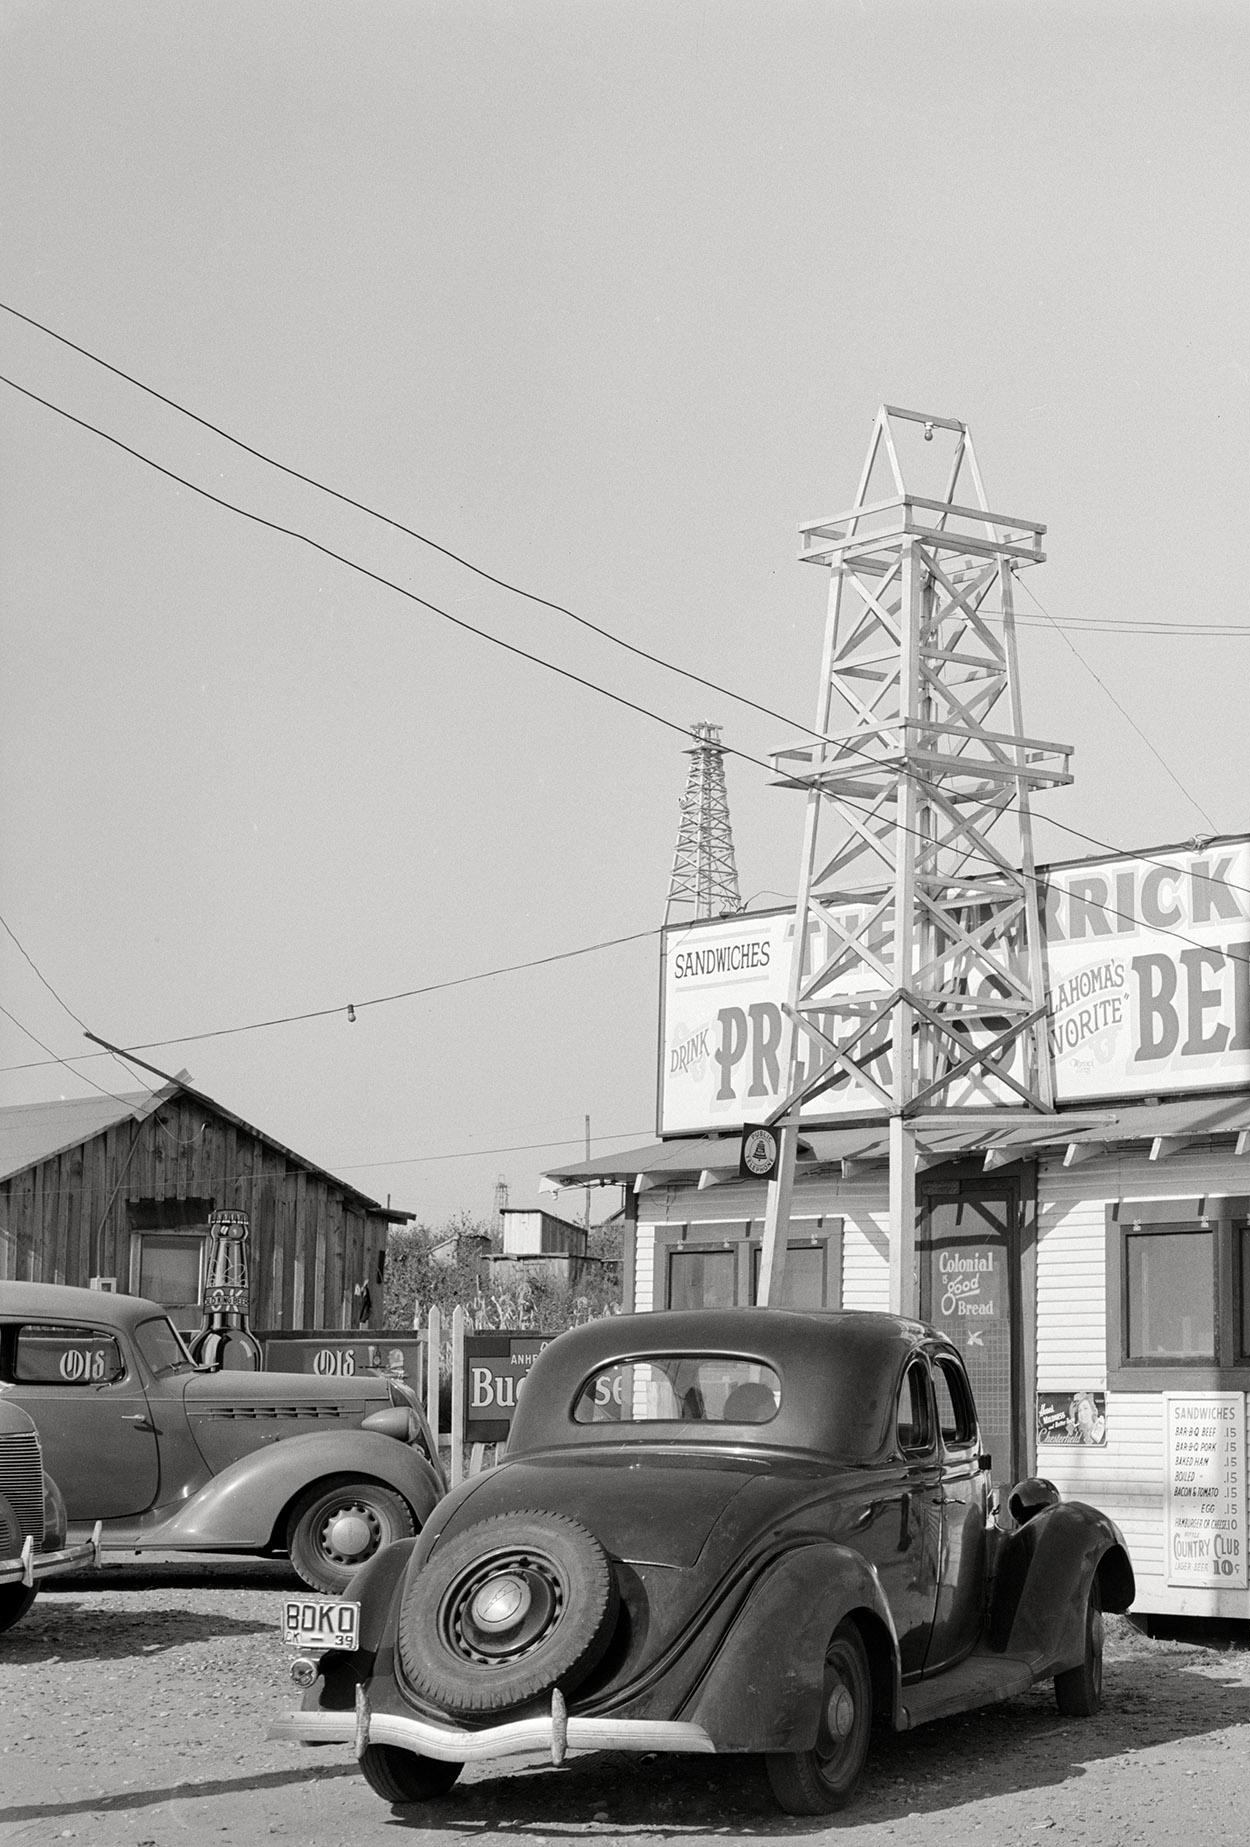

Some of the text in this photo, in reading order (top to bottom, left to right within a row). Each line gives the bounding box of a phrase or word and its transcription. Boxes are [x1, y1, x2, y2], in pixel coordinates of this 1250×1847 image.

[674, 940, 771, 980] SANDWICHES
[1044, 957, 1125, 1019] LAHOMA'S
[669, 1028, 711, 1074] DRINK
[750, 1130, 772, 1143] PUBLIC
[939, 1251, 994, 1273] Colonial
[957, 1300, 994, 1316] Bread
[1174, 1407, 1236, 1420] SANDWICHES
[1039, 1427, 1083, 1444] Chesterfield
[1201, 1426, 1217, 1437] BEEF
[1200, 1442, 1218, 1452] PORK
[1175, 1456, 1194, 1466] BAKED
[1194, 1457, 1210, 1466] HAM
[1173, 1486, 1192, 1497] BACON
[1197, 1487, 1219, 1497] TOMATO
[1201, 1503, 1215, 1514] EGG
[1213, 1534, 1240, 1559] CLUB
[335, 1635, 354, 1648] 39
